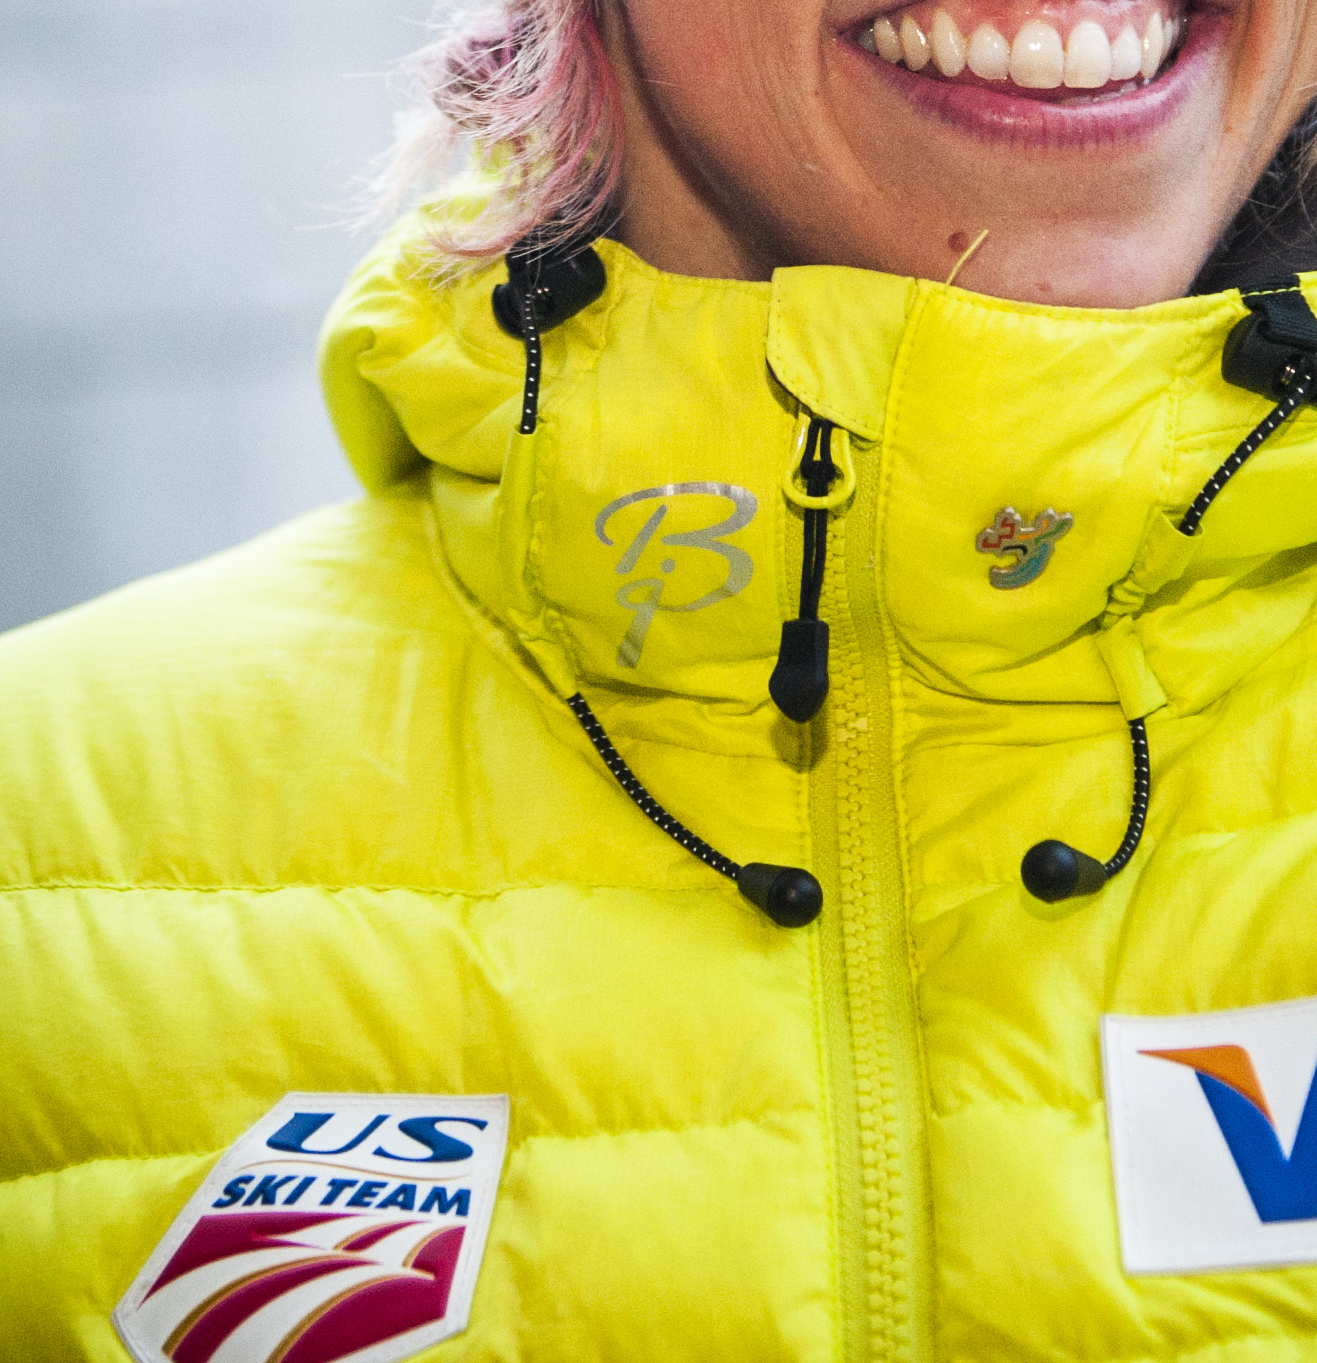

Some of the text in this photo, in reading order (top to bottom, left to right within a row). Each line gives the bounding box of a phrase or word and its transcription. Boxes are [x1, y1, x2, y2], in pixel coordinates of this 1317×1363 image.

[266, 1112, 489, 1163] US
[211, 1173, 472, 1218] SKI TEAM
